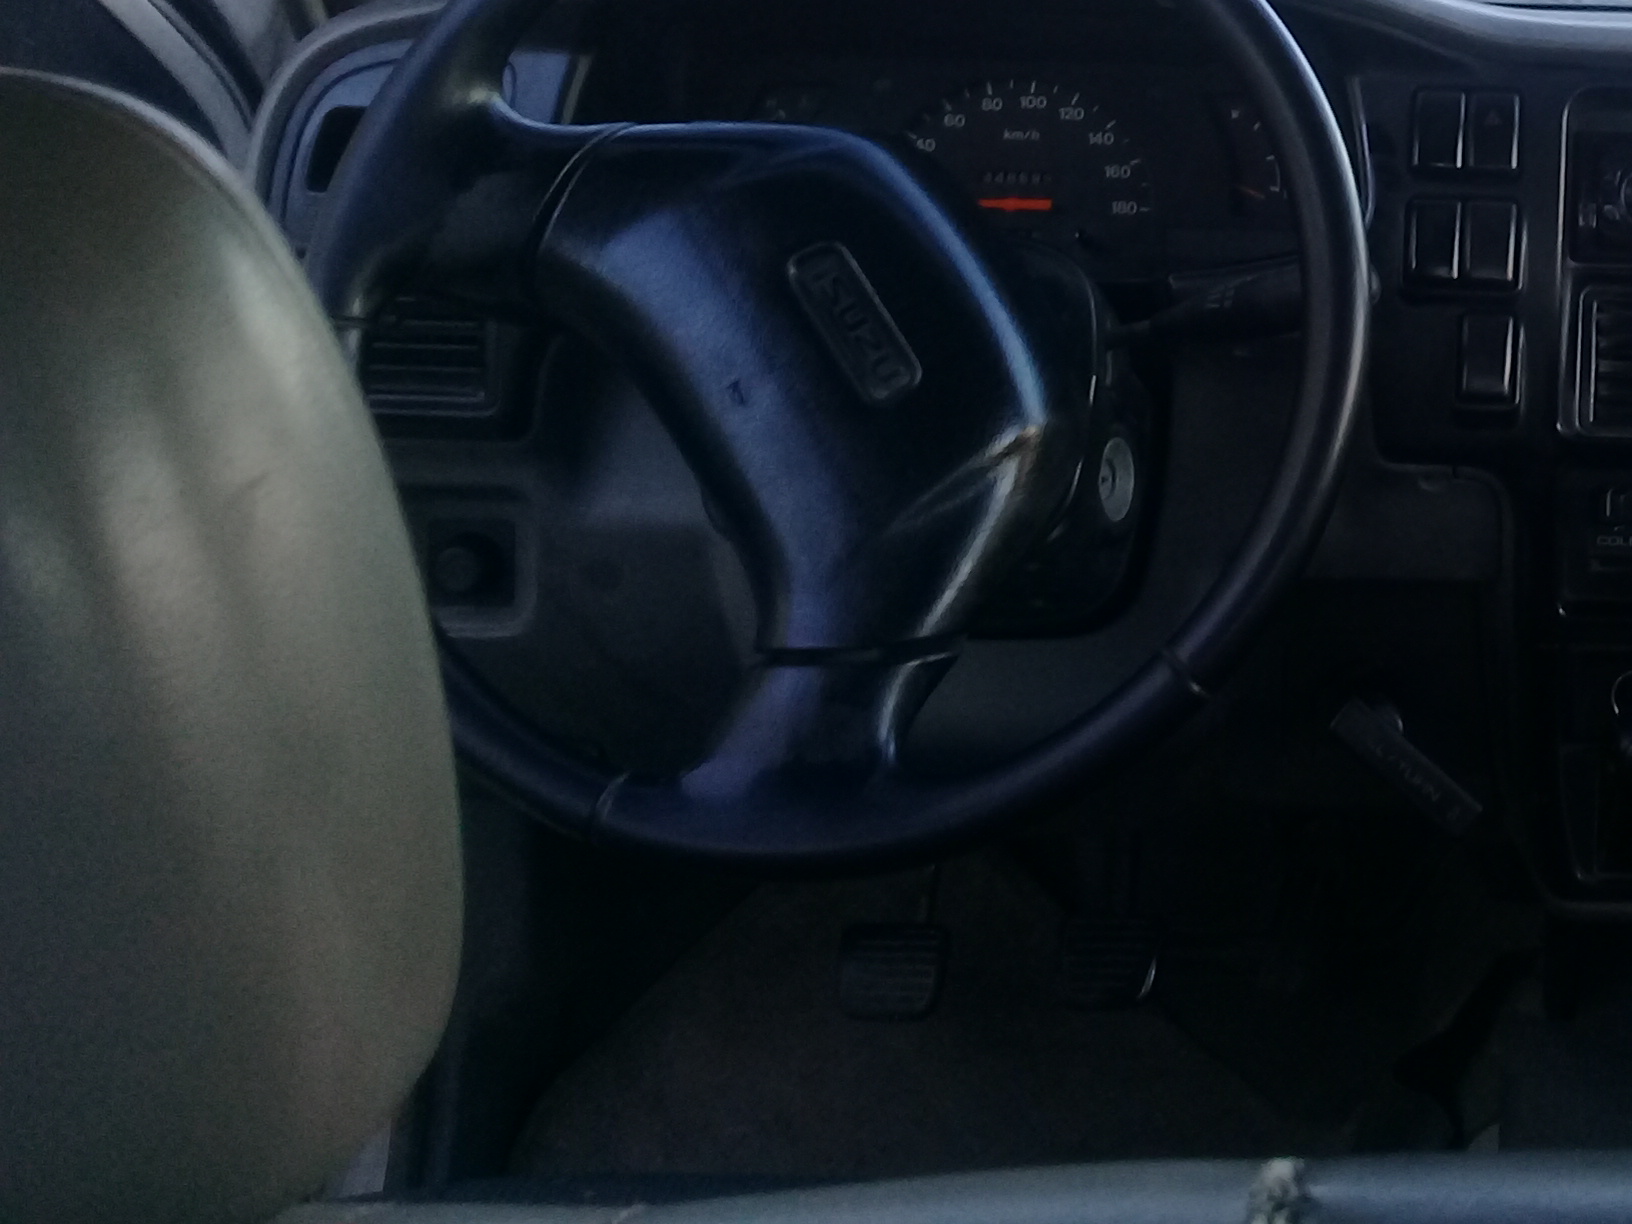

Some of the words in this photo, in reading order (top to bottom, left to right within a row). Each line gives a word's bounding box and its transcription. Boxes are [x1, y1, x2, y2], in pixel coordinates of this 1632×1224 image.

[981, 97, 1003, 111] 80
[1020, 95, 1047, 109] 100
[943, 113, 966, 127] 60
[1059, 107, 1085, 121] 120
[916, 138, 936, 152] 40
[1089, 131, 1115, 145] 140
[1104, 164, 1131, 179] 160
[1111, 200, 1138, 215] 180
